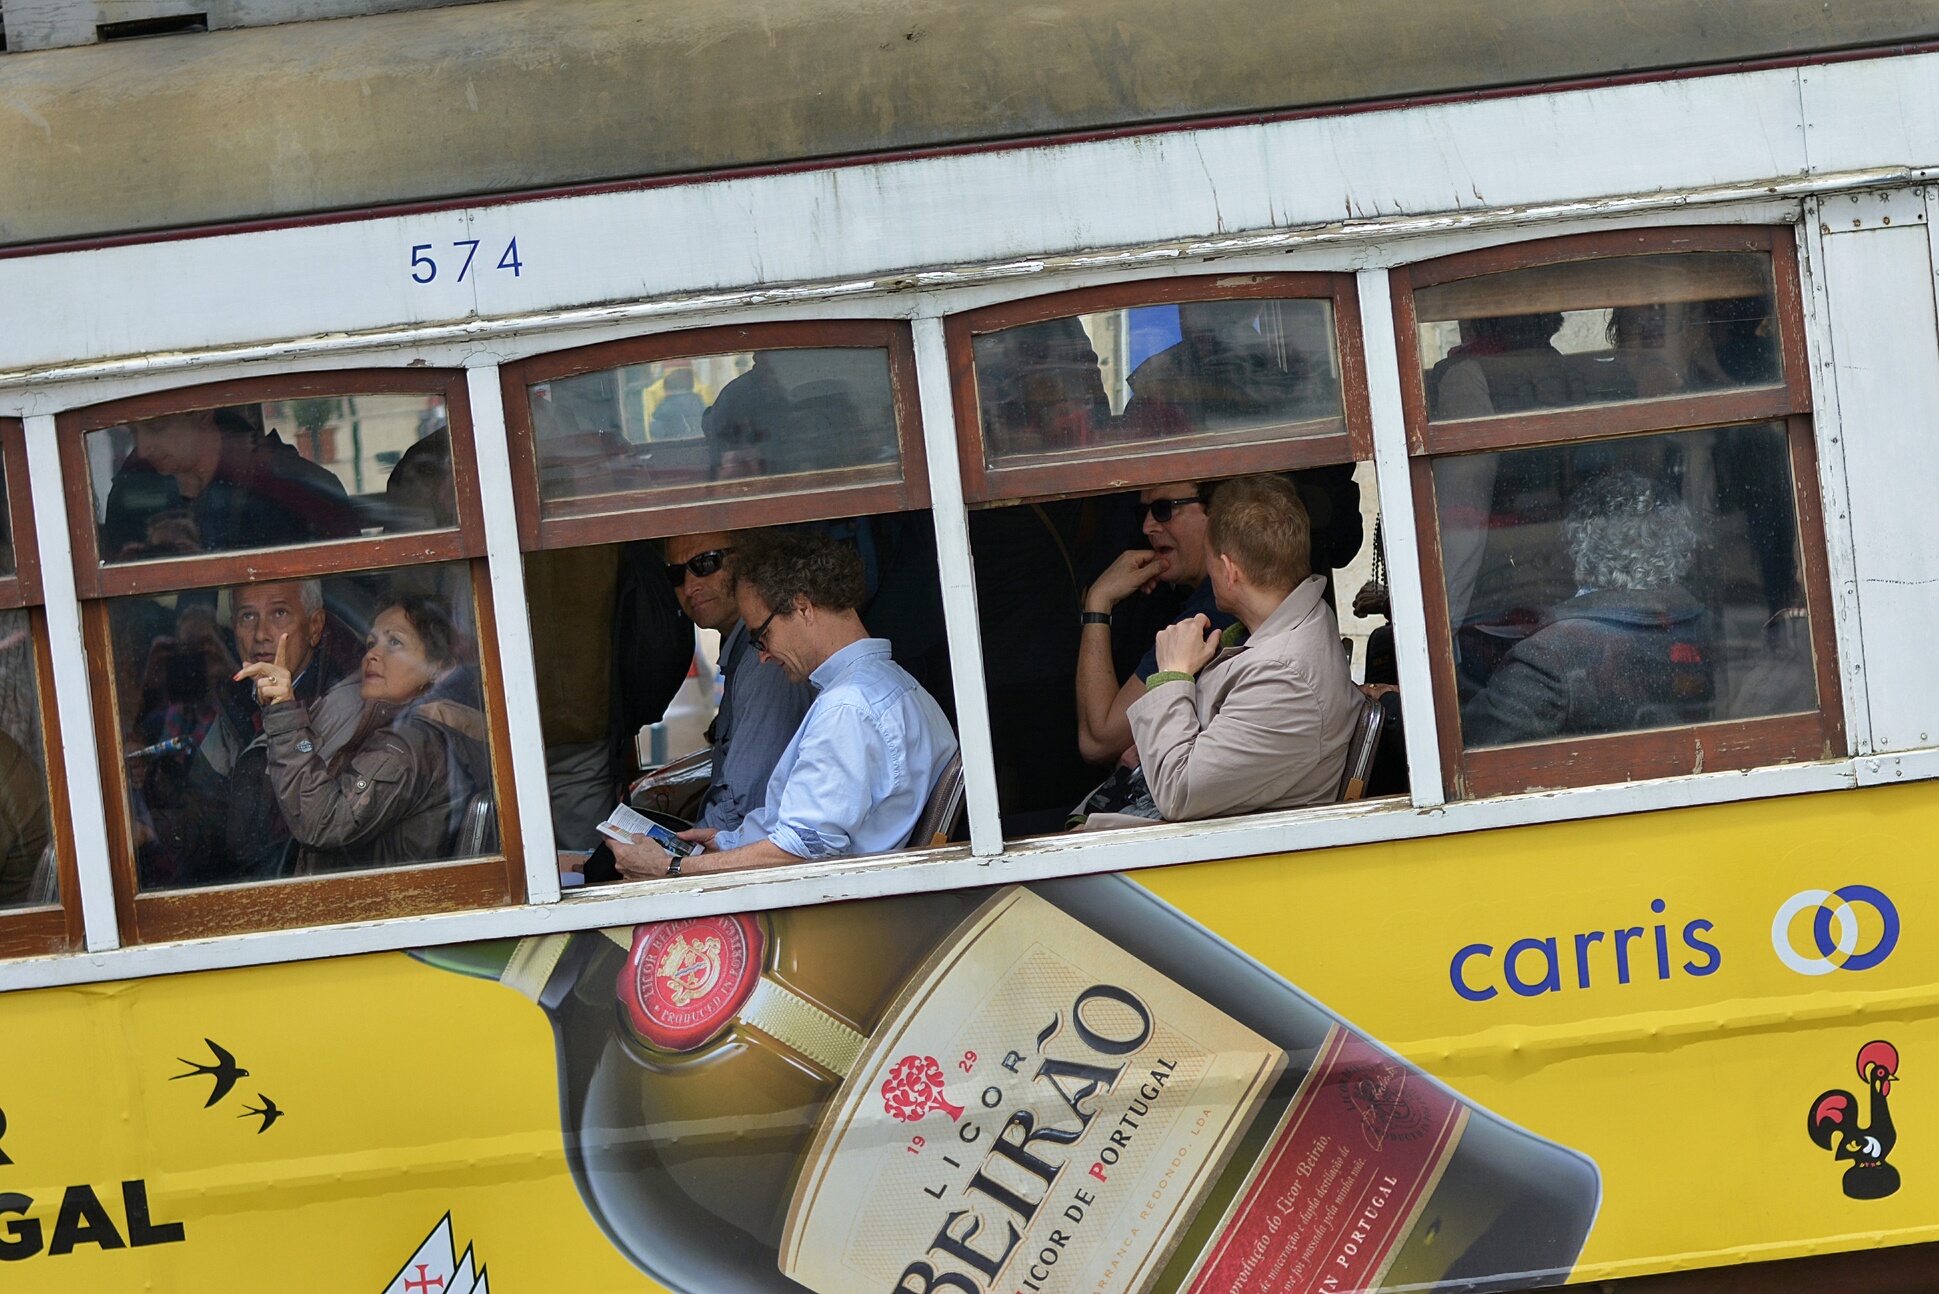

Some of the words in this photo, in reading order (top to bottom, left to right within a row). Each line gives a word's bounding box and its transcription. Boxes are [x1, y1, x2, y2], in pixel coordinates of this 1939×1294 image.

[411, 235, 523, 284] 574
[642, 954, 658, 1002] LICOR
[1449, 898, 1722, 1002] carris
[660, 996, 721, 1024] PRODUCED
[721, 981, 735, 996] IN
[890, 984, 1154, 1294] BEIRÃO
[907, 1135, 926, 1155] 19
[958, 1050, 978, 1073] 29
[923, 1050, 1027, 1200] LICOR
[1191, 1107, 1212, 1136] LDA
[0, 1179, 186, 1262] GAL
[1014, 1229, 1071, 1294] ICOR
[1063, 1187, 1096, 1225] DE
[1088, 1057, 1178, 1183] PORTUGAL
[1258, 1279, 1272, 1293] de
[1299, 1197, 1321, 1225] dupla
[1315, 1156, 1344, 1198] destilação
[1338, 1145, 1350, 1158] de
[1266, 1215, 1282, 1234] do
[1276, 1179, 1302, 1216] Licor
[1296, 1136, 1332, 1178] Beirão,
[1283, 1275, 1297, 1292] me
[1290, 1260, 1305, 1284] foi
[1301, 1224, 1327, 1268] passada
[1323, 1204, 1339, 1232] pela
[1335, 1176, 1355, 1206] minha
[1318, 1274, 1339, 1294] IN
[1336, 1175, 1398, 1269] PORTUGAL
